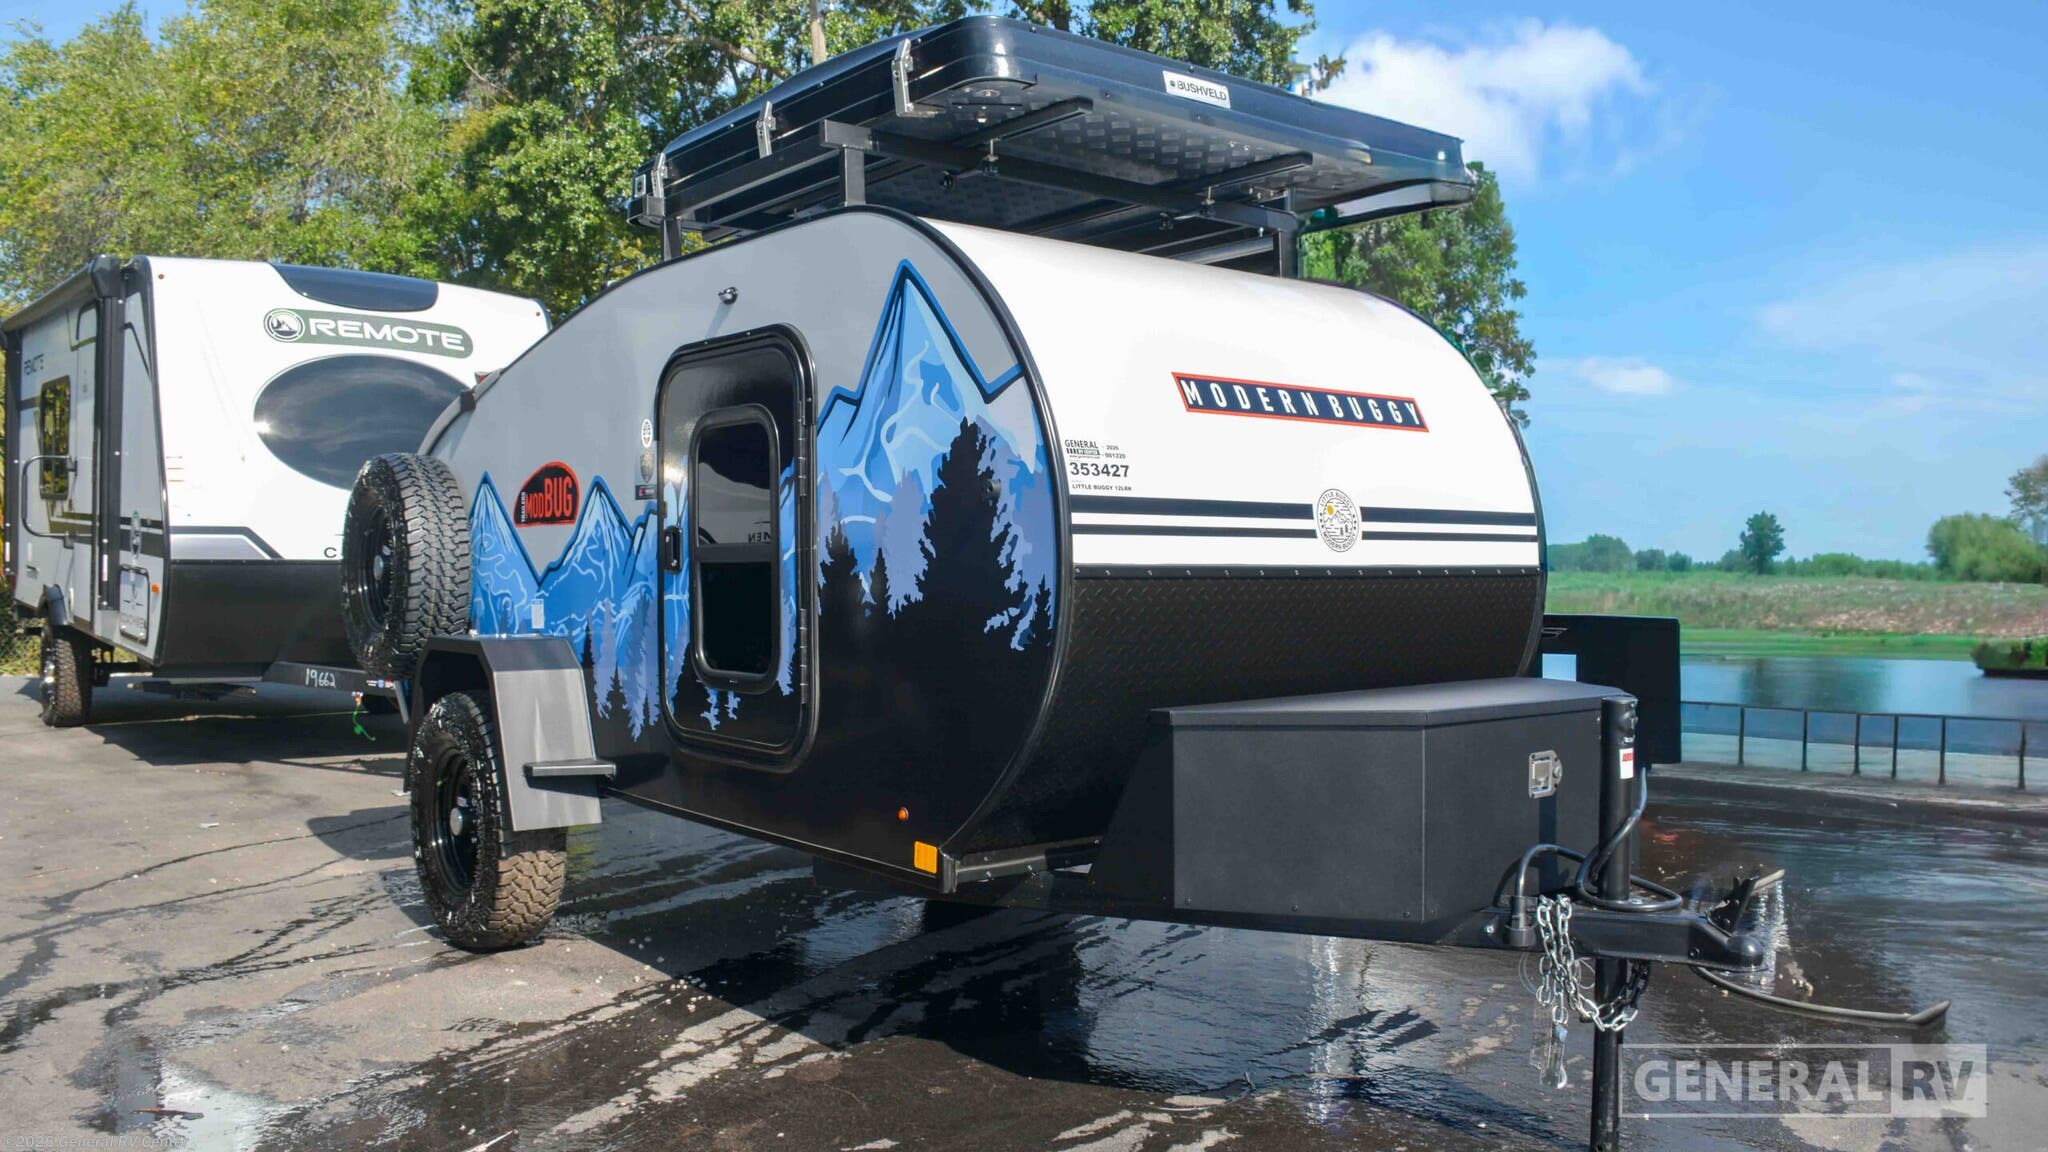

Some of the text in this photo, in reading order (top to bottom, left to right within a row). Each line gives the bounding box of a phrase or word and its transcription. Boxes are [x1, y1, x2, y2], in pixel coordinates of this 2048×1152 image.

[1177, 80, 1227, 101] BUSHVELD
[308, 317, 465, 351] REMOTE
[1180, 379, 1421, 425] MODERN BUGGY
[1064, 439, 1099, 449] GENERAL
[1069, 462, 1129, 478] 353427
[305, 668, 336, 688] 19662
